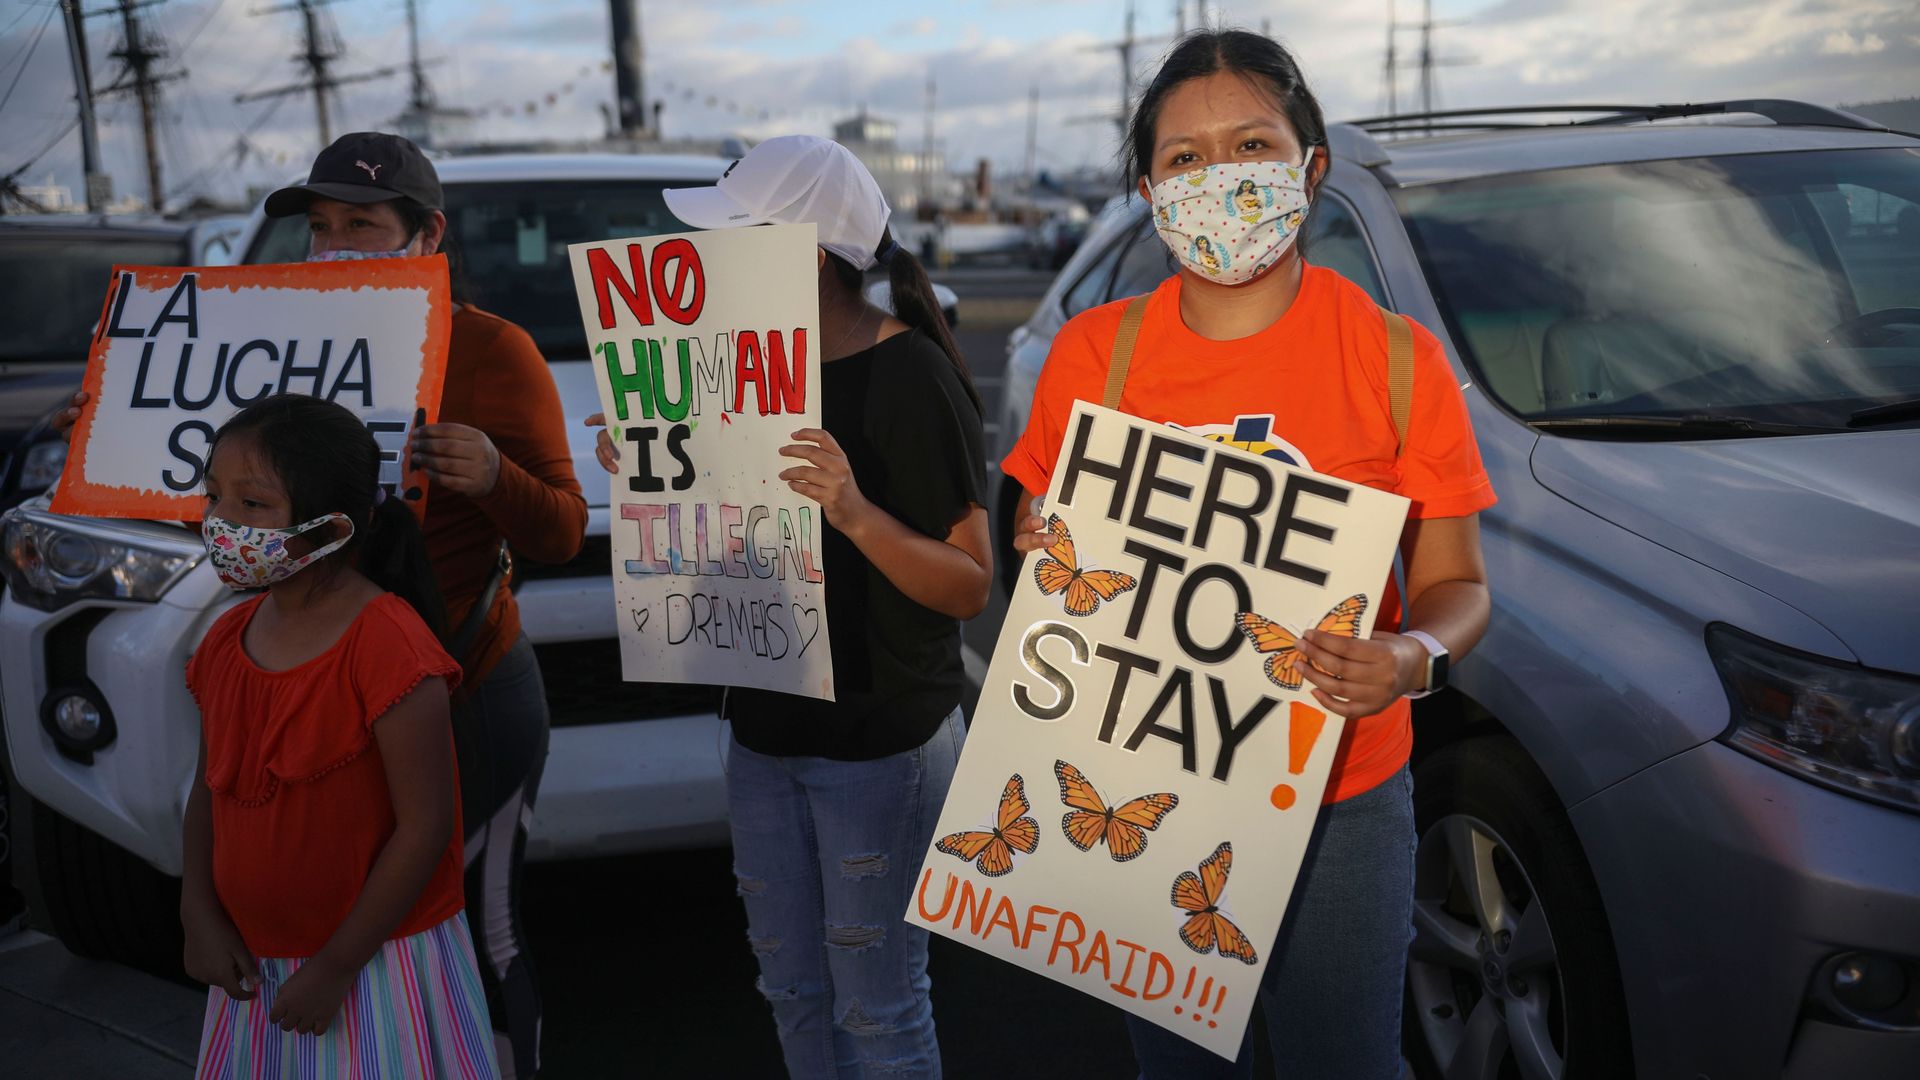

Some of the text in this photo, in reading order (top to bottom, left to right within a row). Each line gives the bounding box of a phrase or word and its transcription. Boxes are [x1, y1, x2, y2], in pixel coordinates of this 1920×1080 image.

[130, 338, 373, 410] LUCHA
[604, 327, 807, 422] HUMAN
[625, 423, 696, 493] IS
[1057, 411, 1352, 588] HERE
[621, 502, 823, 584] ILLEGAL
[1123, 537, 1253, 665] TO
[917, 867, 1227, 1029] UNAFRAID!!!
